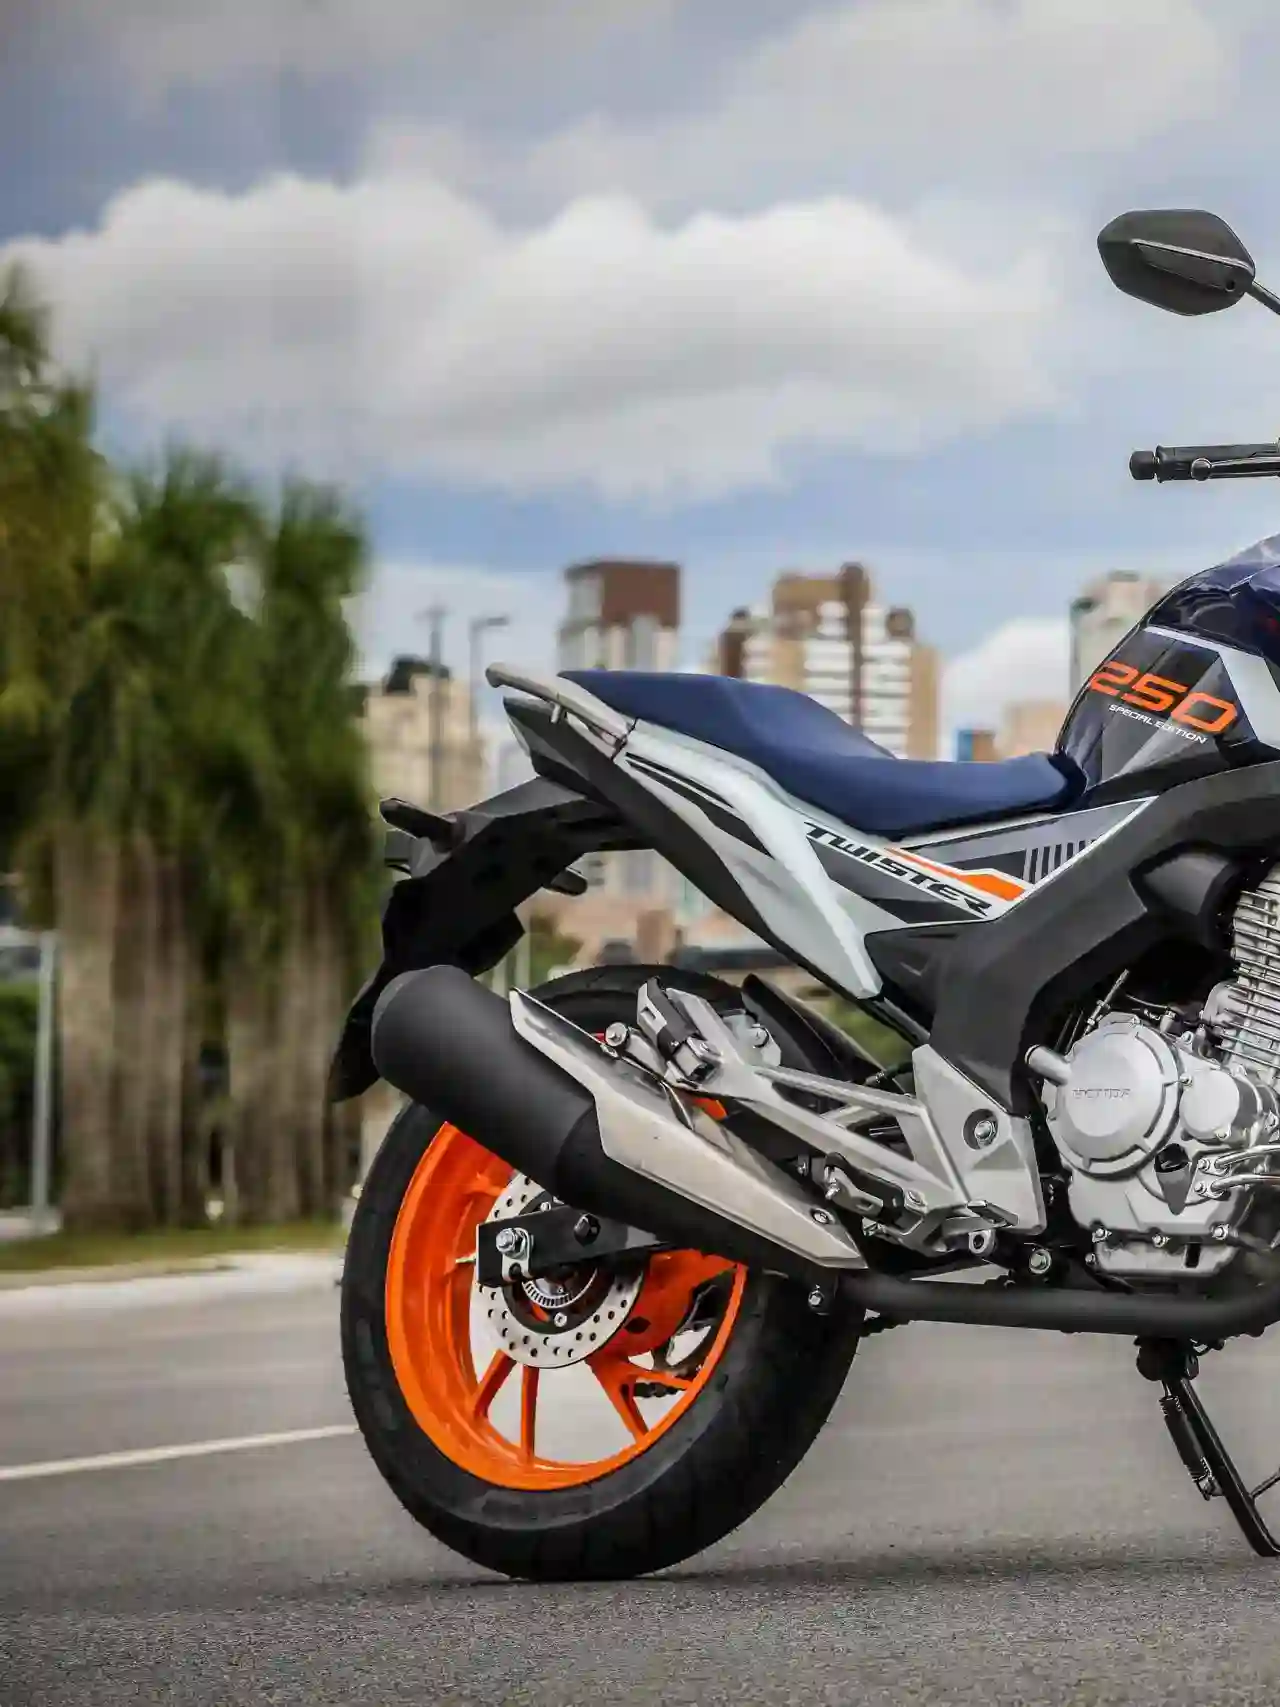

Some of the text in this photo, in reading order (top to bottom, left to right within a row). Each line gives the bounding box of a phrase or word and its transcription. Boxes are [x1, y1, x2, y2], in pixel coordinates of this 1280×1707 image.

[1090, 660, 1237, 733] 250
[1109, 704, 1208, 744] SPECIAL EDITION
[804, 821, 992, 917] TWISTER
